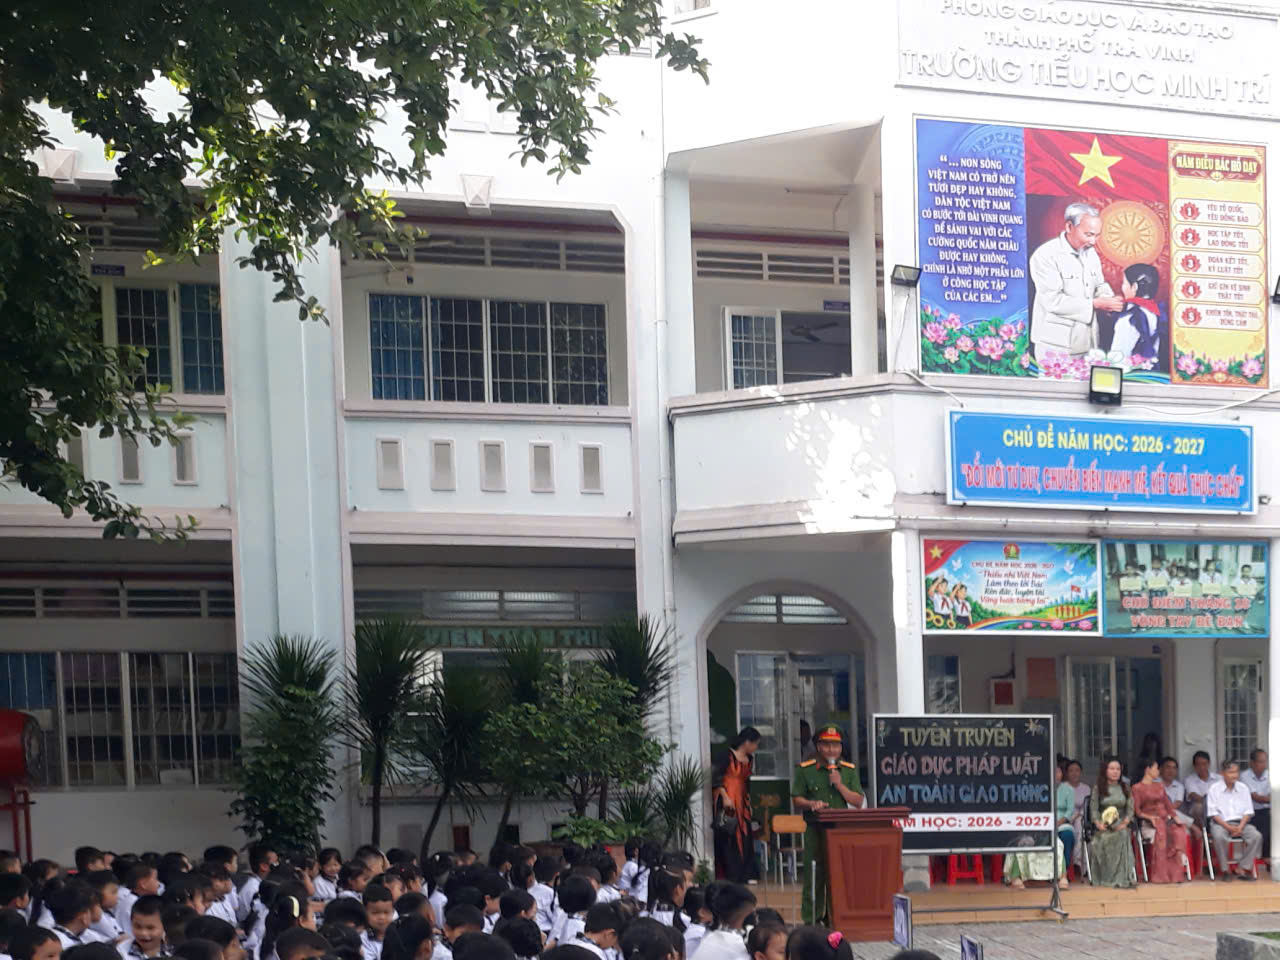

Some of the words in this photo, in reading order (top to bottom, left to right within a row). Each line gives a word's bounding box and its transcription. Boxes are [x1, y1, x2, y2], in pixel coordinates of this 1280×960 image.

[1193, 22, 1234, 43] TẠO
[984, 27, 1051, 50] THÀNH
[1101, 38, 1141, 58] TRÀ
[1144, 45, 1196, 63] VINH
[902, 46, 1024, 84] TRƯỜNG
[1091, 68, 1155, 99] HỌC
[1161, 73, 1230, 101] MINH
[960, 158, 978, 168] NON
[1176, 154, 1194, 169] NĂM
[1214, 157, 1230, 171] BÁC
[1230, 156, 1242, 172] HỒ
[1242, 160, 1258, 176] DẠY
[928, 169, 948, 182] VIỆT
[950, 171, 968, 182] NAM
[968, 185, 985, 196] HAY
[972, 197, 991, 210] VIỆT
[992, 200, 1011, 211] NAM
[1186, 207, 1192, 217] 1
[980, 213, 998, 223] VINH
[1000, 214, 1024, 226] QUANG
[968, 225, 982, 236] VAI
[1186, 232, 1194, 242] 2
[962, 252, 978, 262] HAY
[1187, 259, 1194, 268] 3
[972, 279, 990, 290] HỌC
[1188, 285, 1194, 296] 4
[1188, 311, 1195, 322] 5
[1002, 424, 1034, 448] CHỦ
[1037, 421, 1055, 449] ĐỀ
[1057, 427, 1090, 451] NĂM
[1092, 433, 1129, 456] HỌC:
[1131, 433, 1163, 454] 2026
[1173, 435, 1206, 456] 2027
[986, 456, 1006, 490] MỚI
[1006, 461, 1020, 490] TƯ
[1168, 615, 1192, 628] TAY
[900, 722, 951, 747] TUYÊN
[880, 751, 917, 776] GIÁO
[921, 755, 953, 780] DỤC
[956, 751, 1000, 776] PHÁP
[1002, 752, 1042, 778] LUẬT
[880, 784, 906, 804] AN
[909, 780, 955, 804] TOÀN
[959, 783, 999, 804] GIAO
[1000, 780, 1049, 804] THÔNG
[922, 817, 962, 830] HỌC:
[967, 816, 1003, 828] 2026
[1016, 816, 1050, 827] 2027
